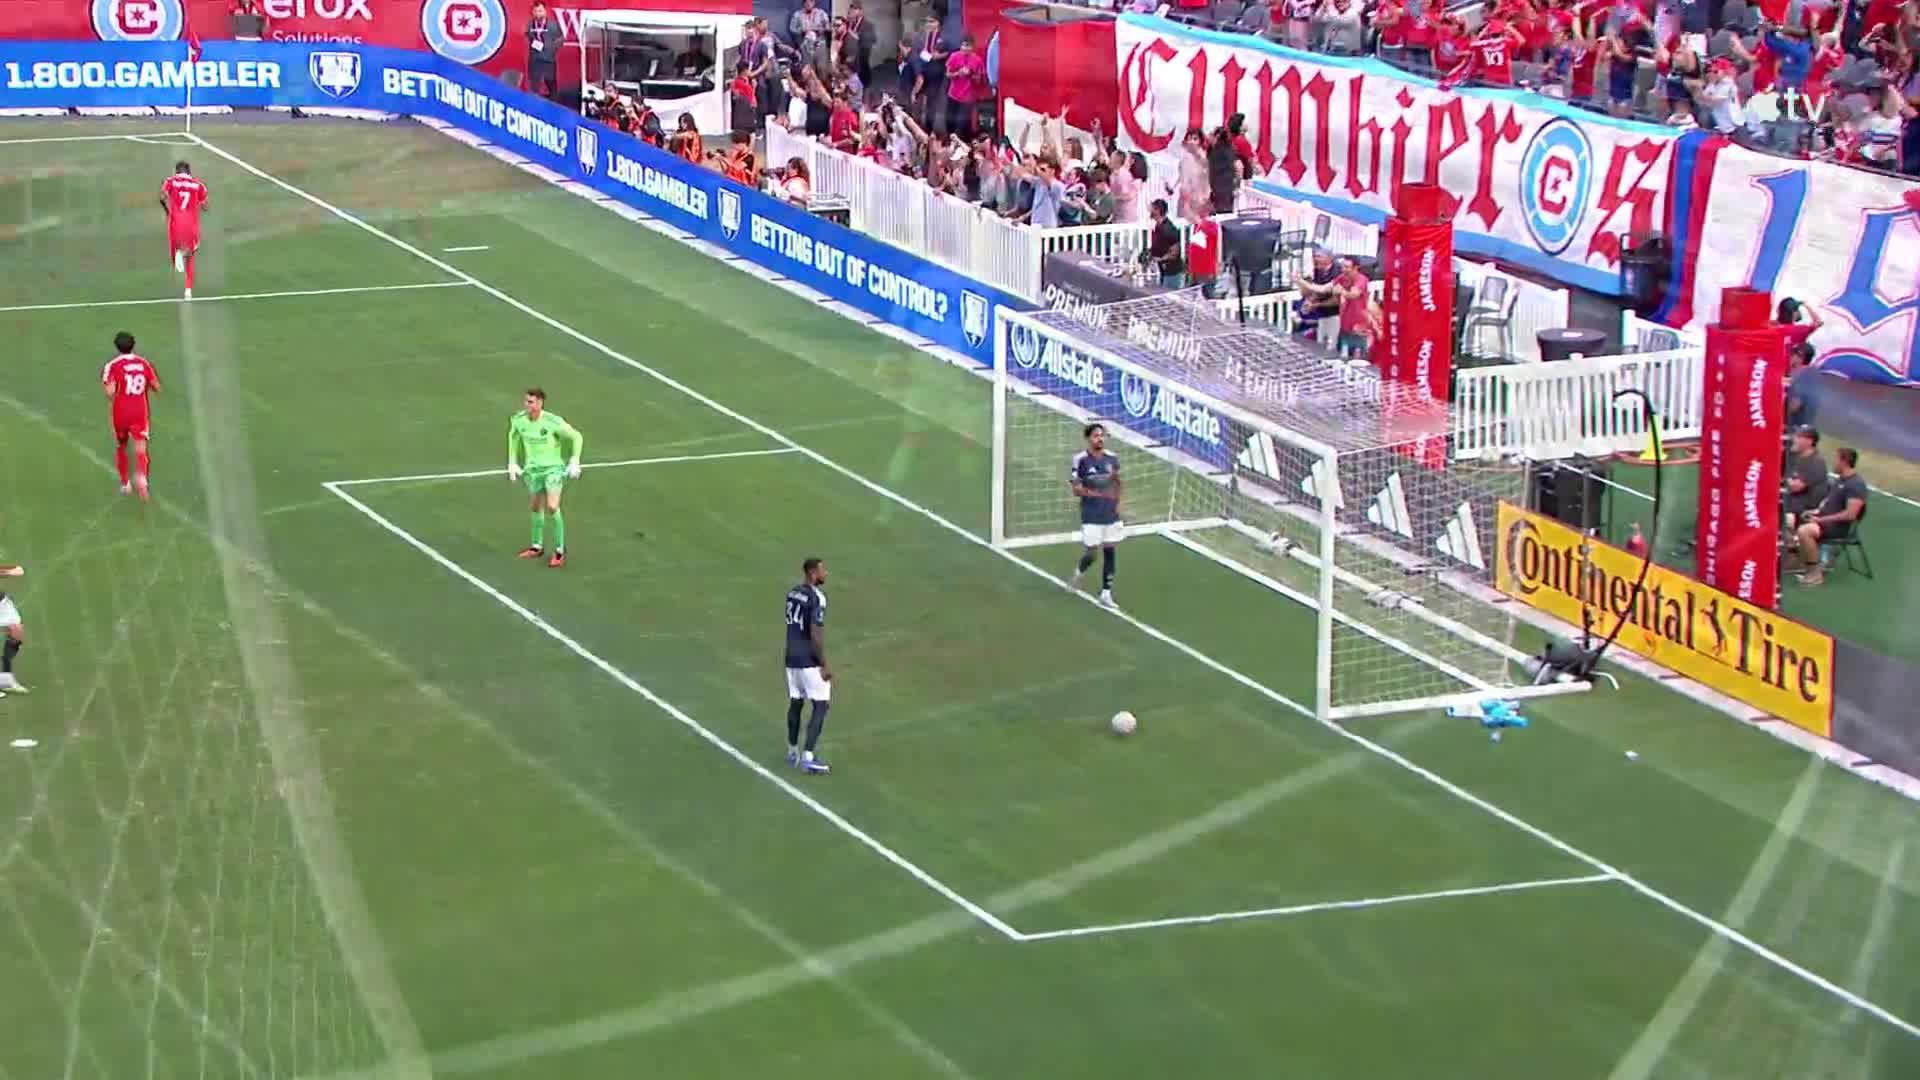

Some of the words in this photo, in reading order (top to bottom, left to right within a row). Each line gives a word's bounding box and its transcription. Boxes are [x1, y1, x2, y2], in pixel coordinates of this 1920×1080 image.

[263, 0, 374, 21] erox
[5, 61, 281, 89] 1.800.GAMBLER
[383, 67, 463, 110] BETTING
[463, 88, 489, 121] OUT
[488, 99, 506, 129] OF
[505, 107, 567, 157] CONTROL?
[178, 191, 190, 209] 7
[606, 150, 709, 220] 1.800.GAMBLER
[751, 213, 814, 266] BETTING
[814, 241, 846, 280] OUT
[846, 255, 868, 288] OF
[867, 263, 949, 323] CONTROL?
[1418, 247, 1437, 312] JAMESON
[124, 373, 146, 395] 18
[1039, 333, 1105, 395] Allstate
[1747, 357, 1769, 430] JAMESON
[1151, 387, 1220, 444] Allstate
[1743, 459, 1763, 529] JAMESON
[1738, 559, 1758, 599] ESON
[785, 600, 804, 631] 34
[1506, 518, 1696, 649] Continental
[1728, 605, 1820, 703] Tire
